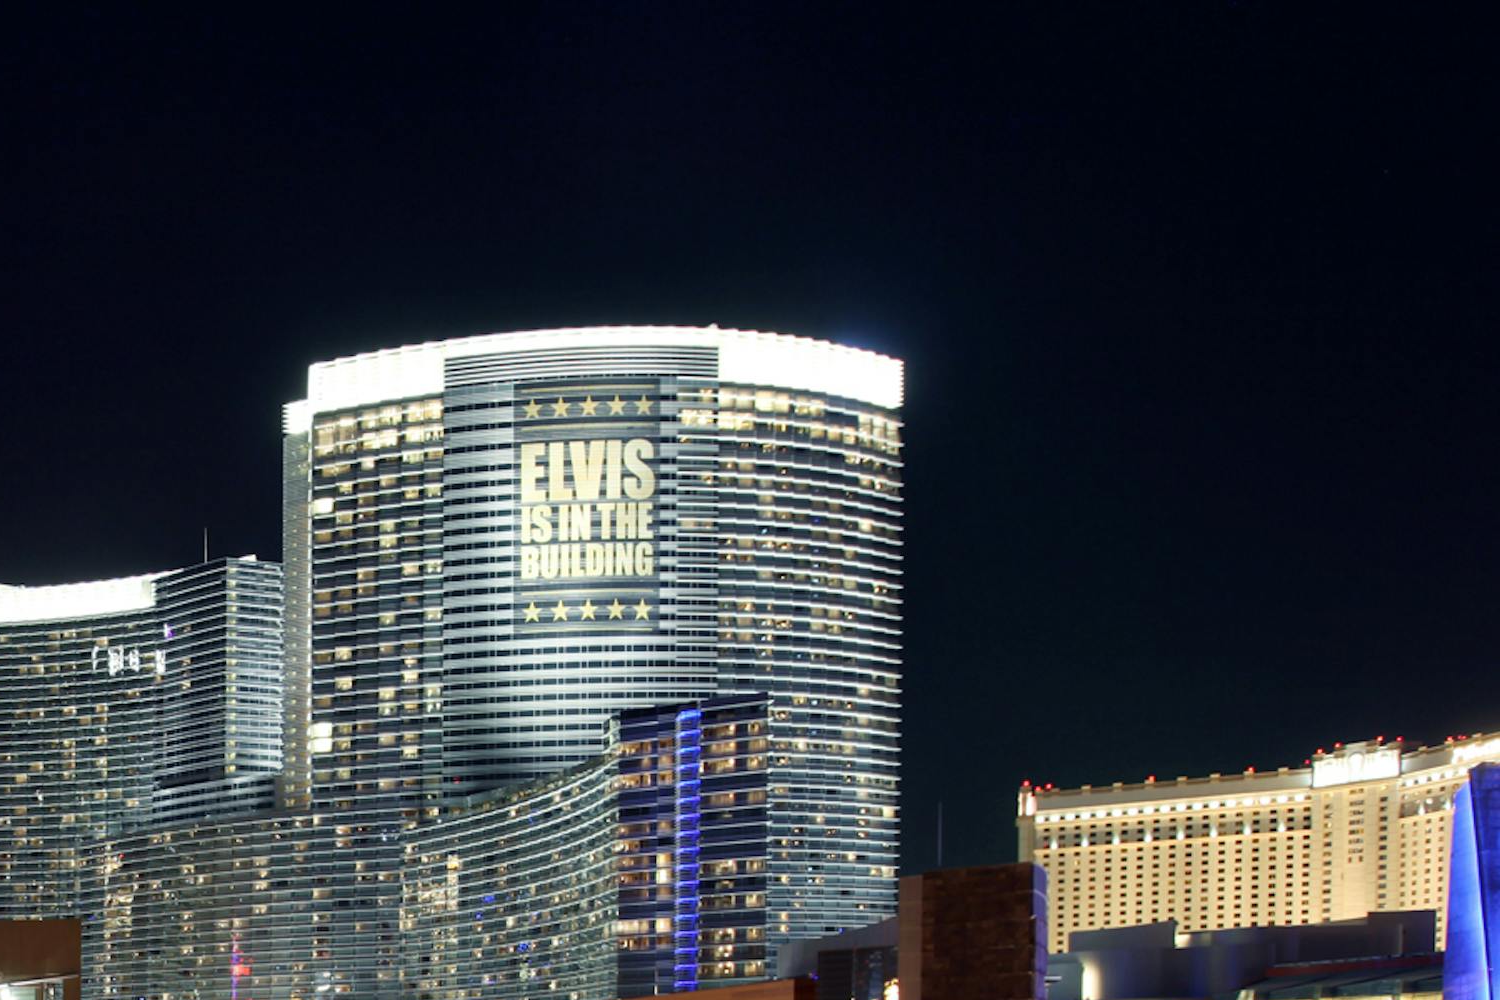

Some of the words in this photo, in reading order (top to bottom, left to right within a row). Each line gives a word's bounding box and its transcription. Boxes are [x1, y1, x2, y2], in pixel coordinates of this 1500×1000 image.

[520, 438, 656, 503] ELVIS
[520, 504, 553, 543] IS
[558, 502, 592, 542] IN
[596, 502, 654, 540] THE
[520, 541, 654, 580] BUILDING
